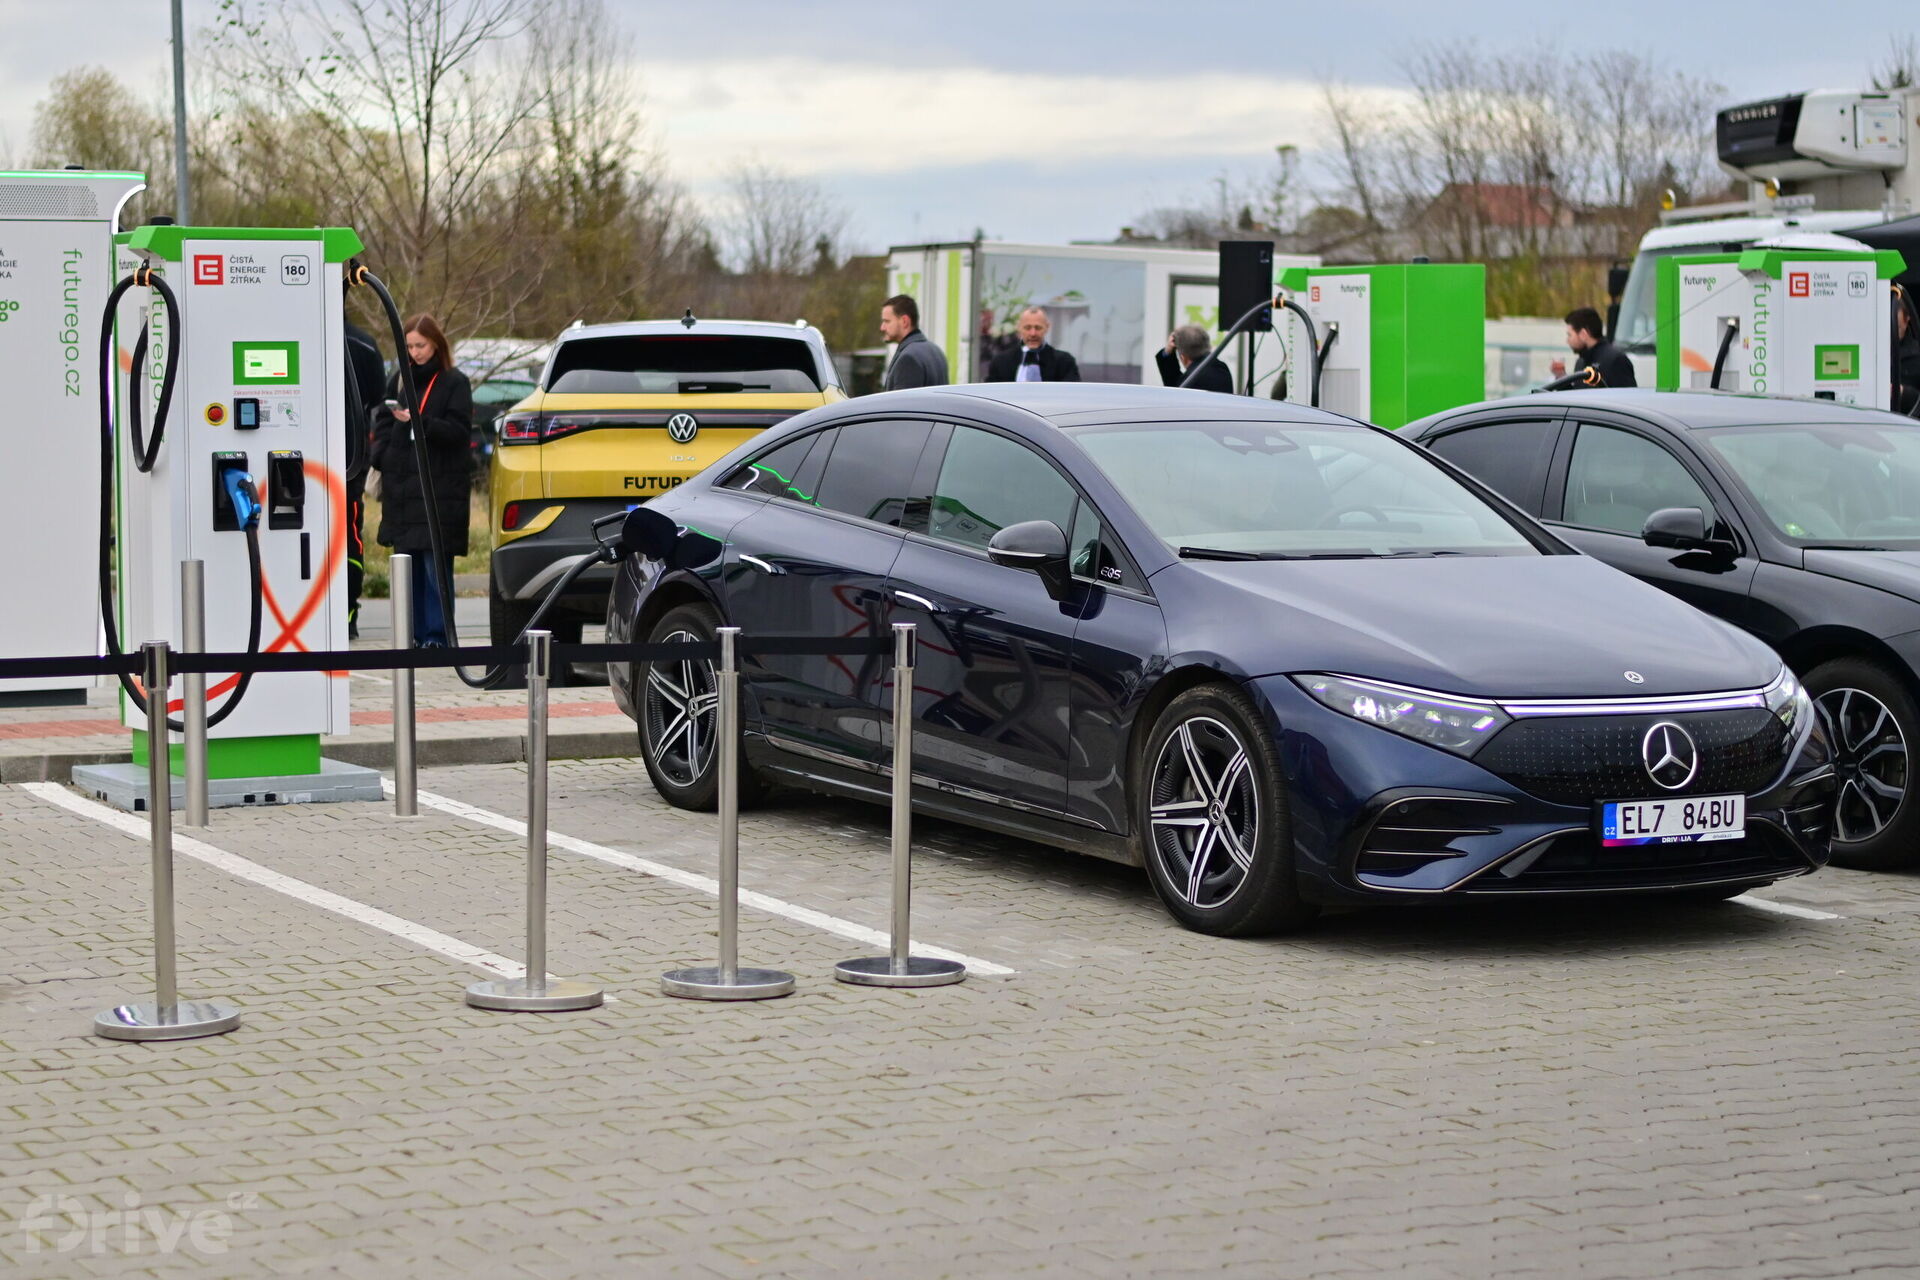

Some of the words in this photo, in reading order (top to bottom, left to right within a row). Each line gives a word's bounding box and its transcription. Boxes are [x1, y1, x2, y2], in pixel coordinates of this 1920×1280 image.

[1728, 104, 1777, 123] CARRIER
[229, 254, 255, 264] ČISTÁ
[229, 266, 267, 274] ENERGIE
[284, 265, 307, 276] 180
[229, 275, 262, 285] ZÍTŘKA
[1850, 280, 1865, 289] 180
[59, 247, 83, 397] futurego.cz
[1101, 566, 1122, 580] EQS
[1604, 827, 1616, 836] CZ
[1622, 804, 1665, 835] EL7
[1683, 799, 1735, 830] 84BU
